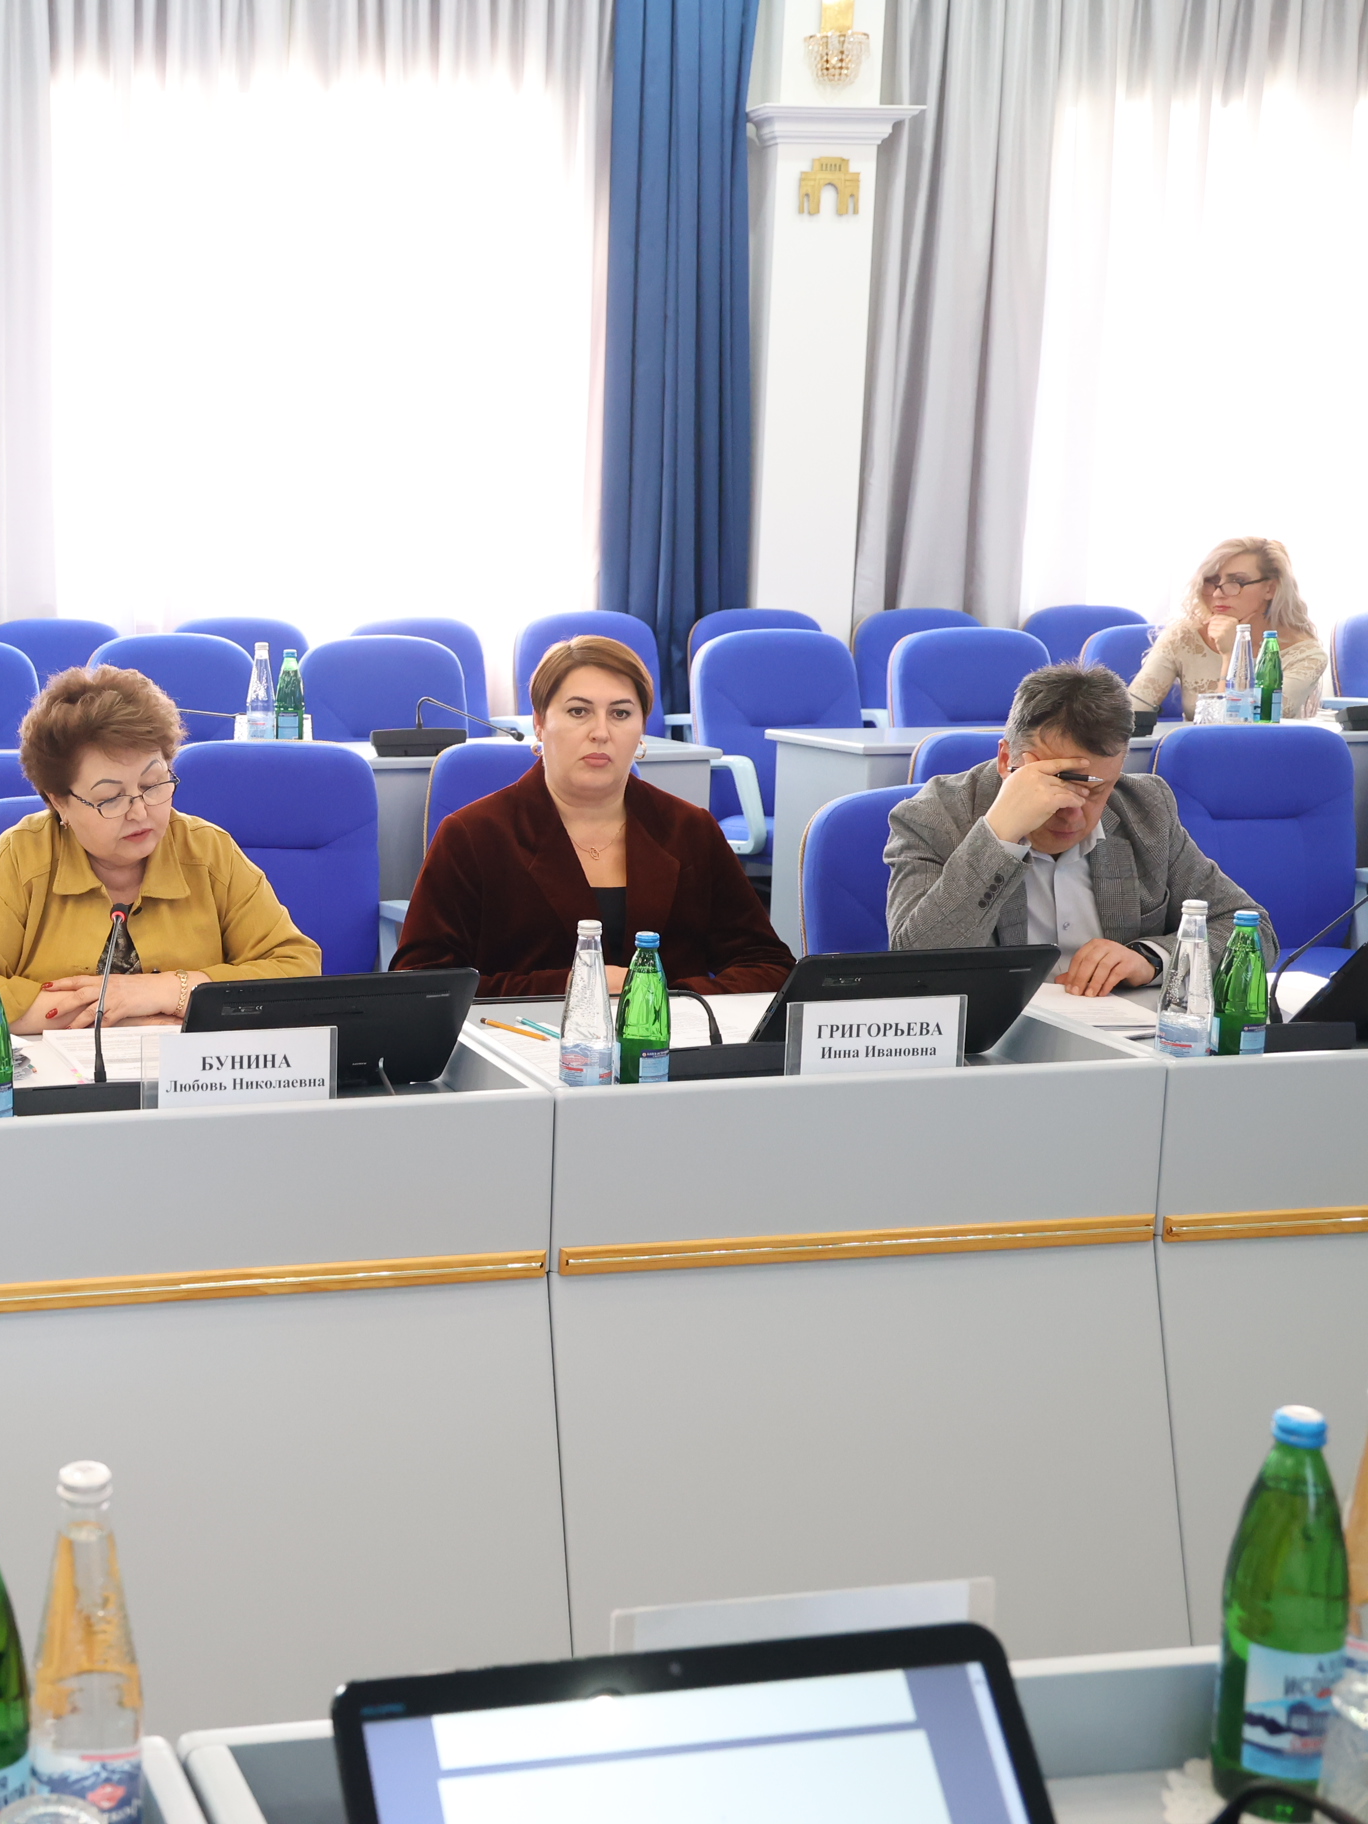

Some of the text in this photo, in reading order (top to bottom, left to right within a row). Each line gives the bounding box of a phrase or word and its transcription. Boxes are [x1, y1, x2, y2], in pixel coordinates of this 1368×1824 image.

[817, 1021, 943, 1039] ГРИГОРЬЕВА
[820, 1045, 937, 1060] Инна Ивановна
[201, 1053, 292, 1072] БУНИНА
[165, 1077, 326, 1093] Любовь Николаевна
